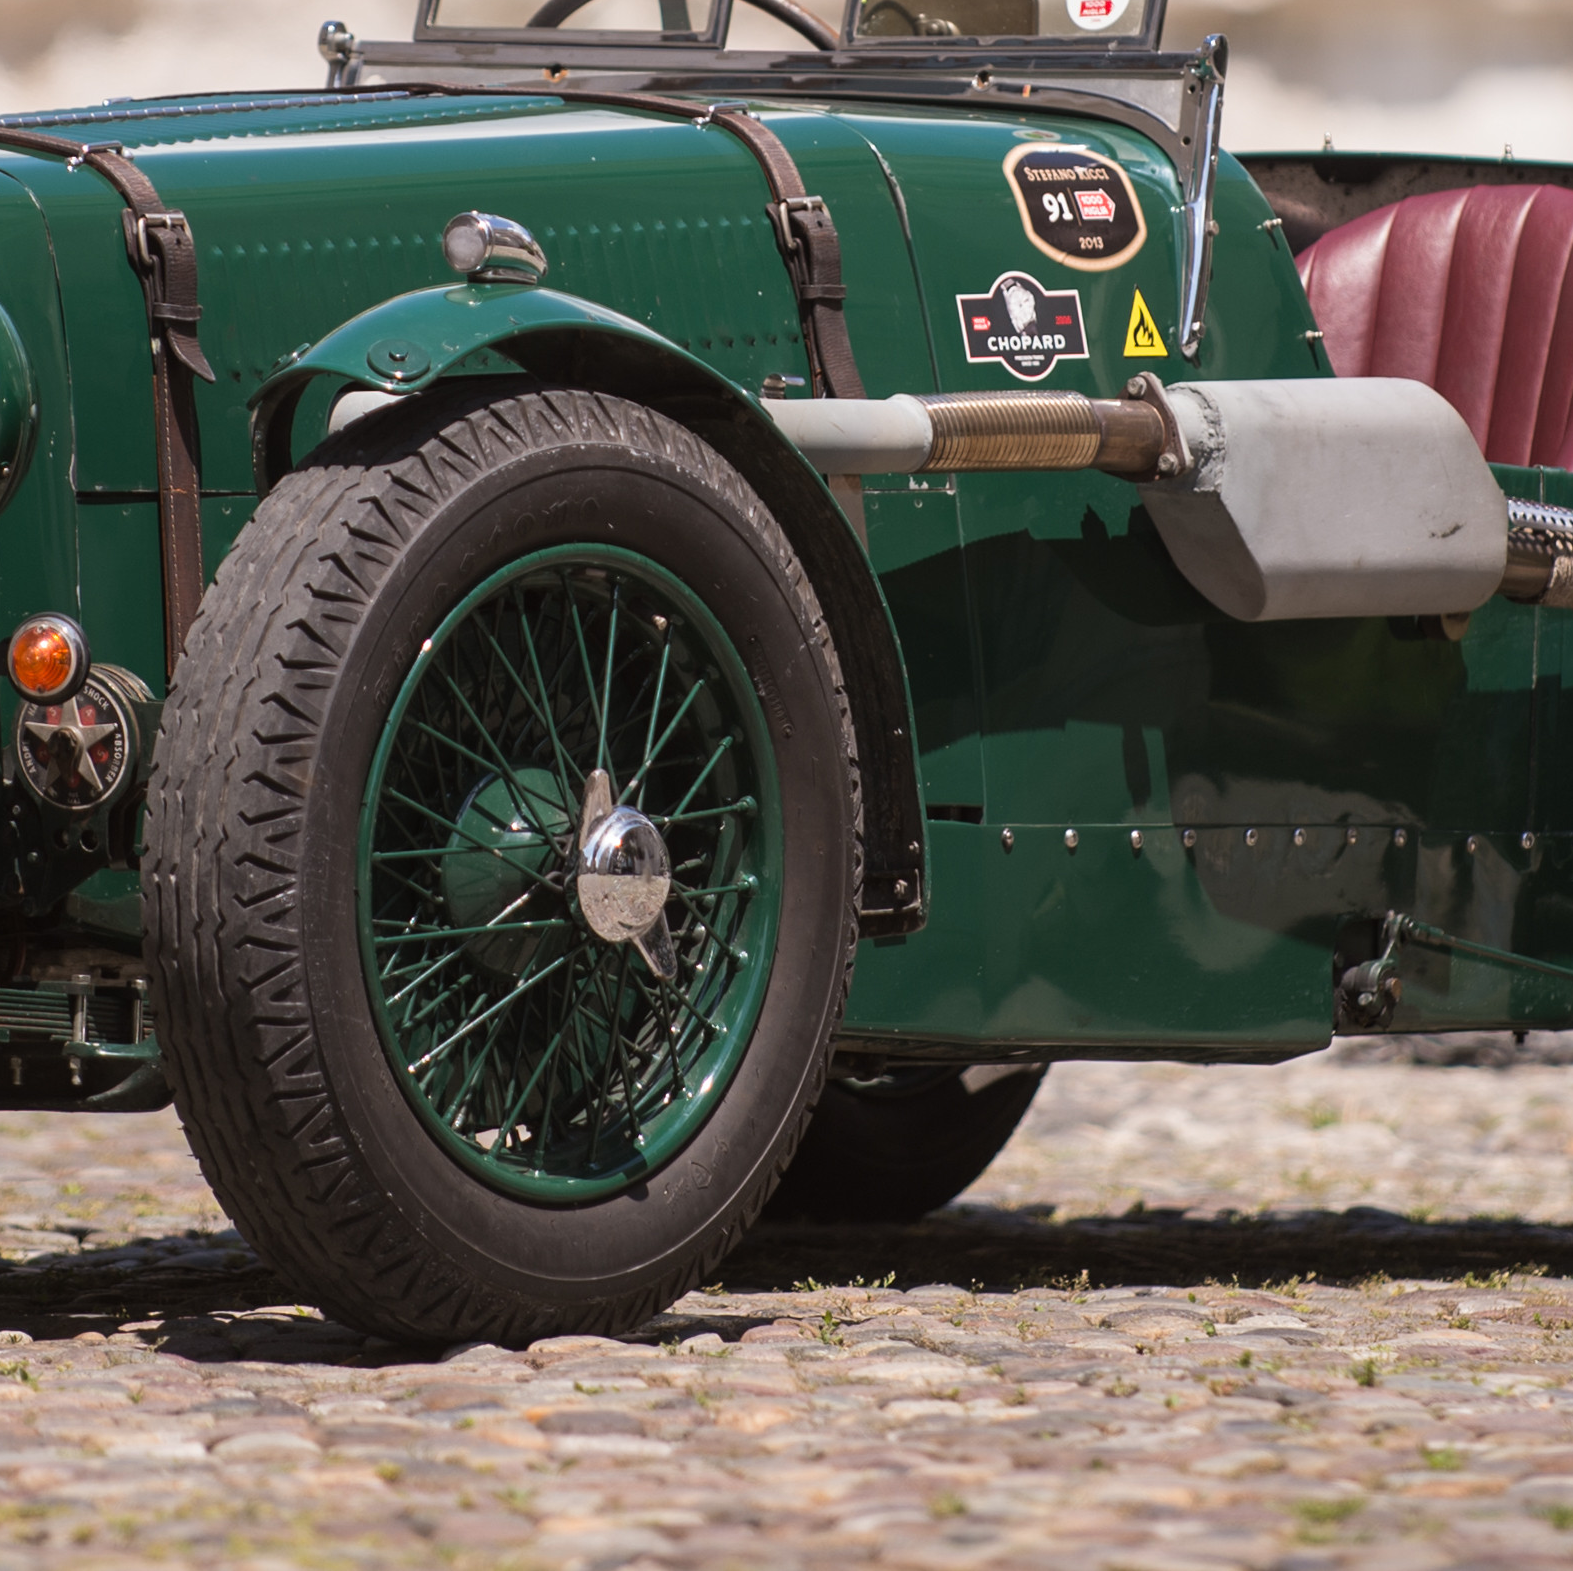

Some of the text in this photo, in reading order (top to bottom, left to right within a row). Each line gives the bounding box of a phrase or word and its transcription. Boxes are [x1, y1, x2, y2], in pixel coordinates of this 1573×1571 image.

[1024, 166, 1110, 182] STEFANO RICCI
[1042, 191, 1073, 222] 91
[1081, 195, 1103, 205] 1000
[1083, 206, 1110, 216] MIGLIA
[1079, 236, 1104, 250] 2013
[987, 334, 1066, 351] CHOPARD
[83, 685, 110, 711] SHOCK
[105, 733, 123, 783] ABSORBER
